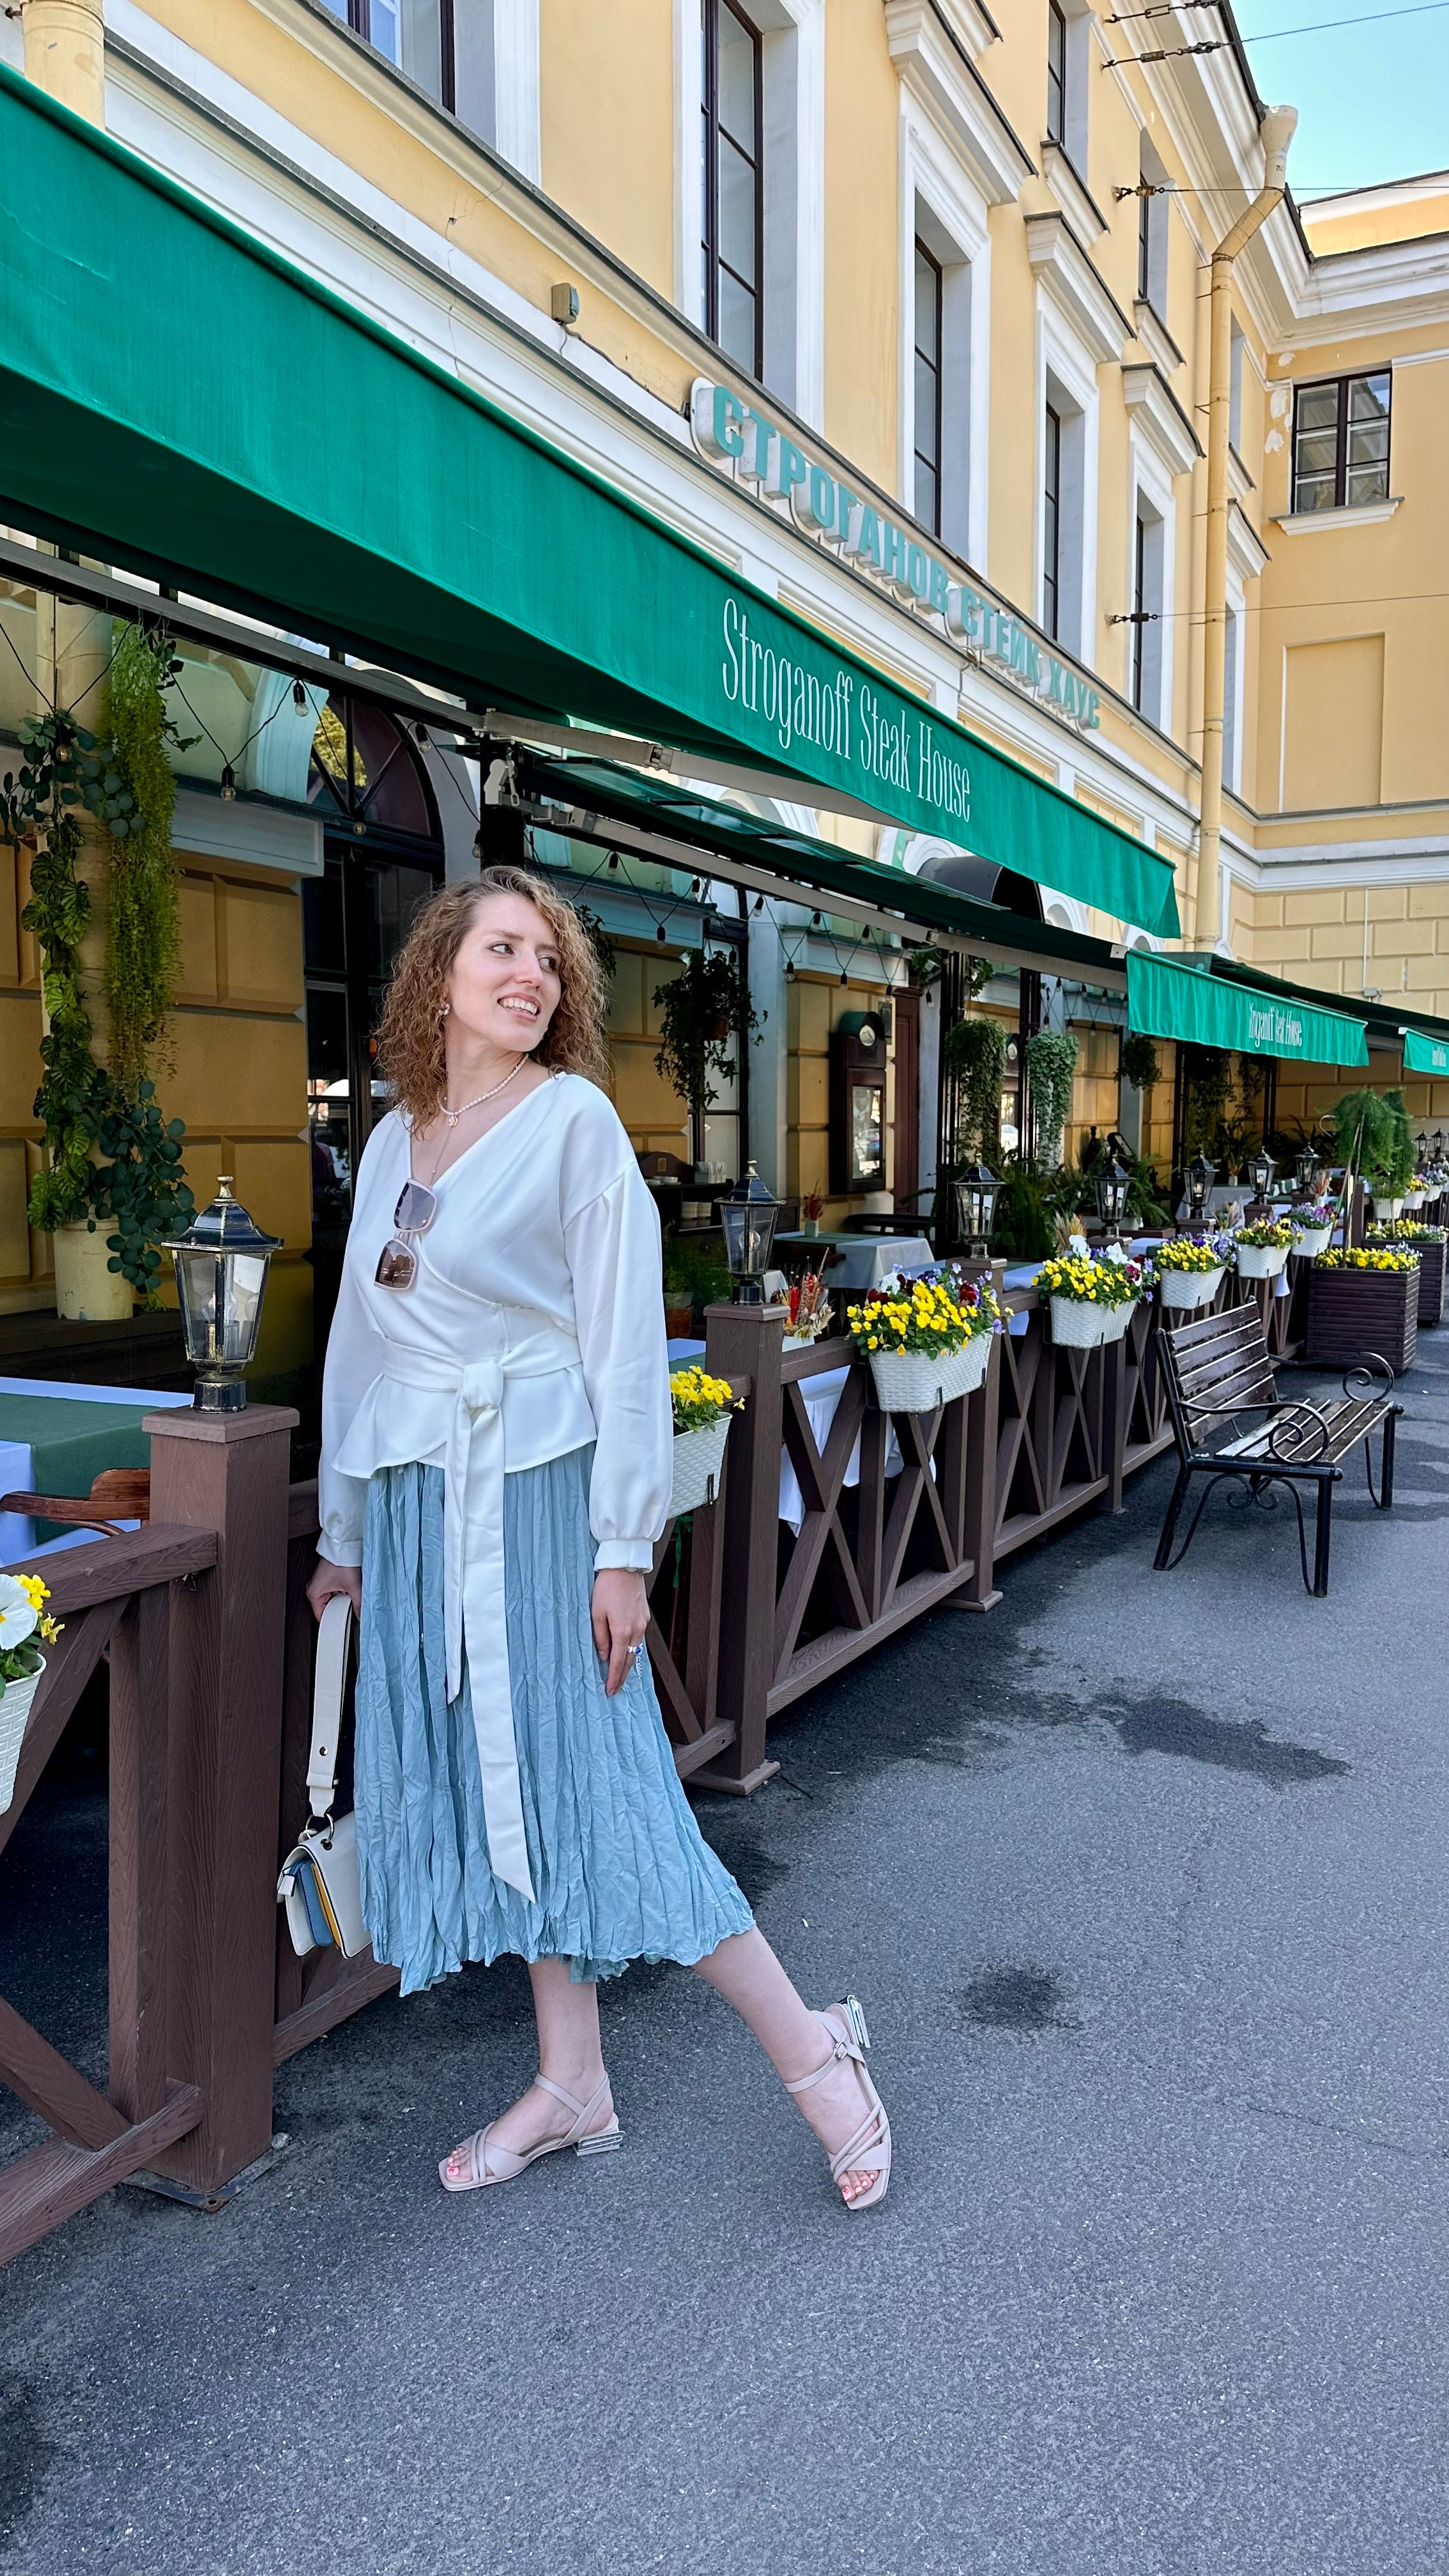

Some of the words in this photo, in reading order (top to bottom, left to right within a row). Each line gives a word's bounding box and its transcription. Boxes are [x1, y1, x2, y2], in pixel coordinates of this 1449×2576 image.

[703, 386, 948, 616] СТРОГАНОВ
[958, 586, 1040, 687] СТЕЙК
[1048, 657, 1100, 730] ХАУС
[723, 599, 854, 760] Stroganoff
[860, 685, 911, 792] Steak
[917, 721, 970, 823] House
